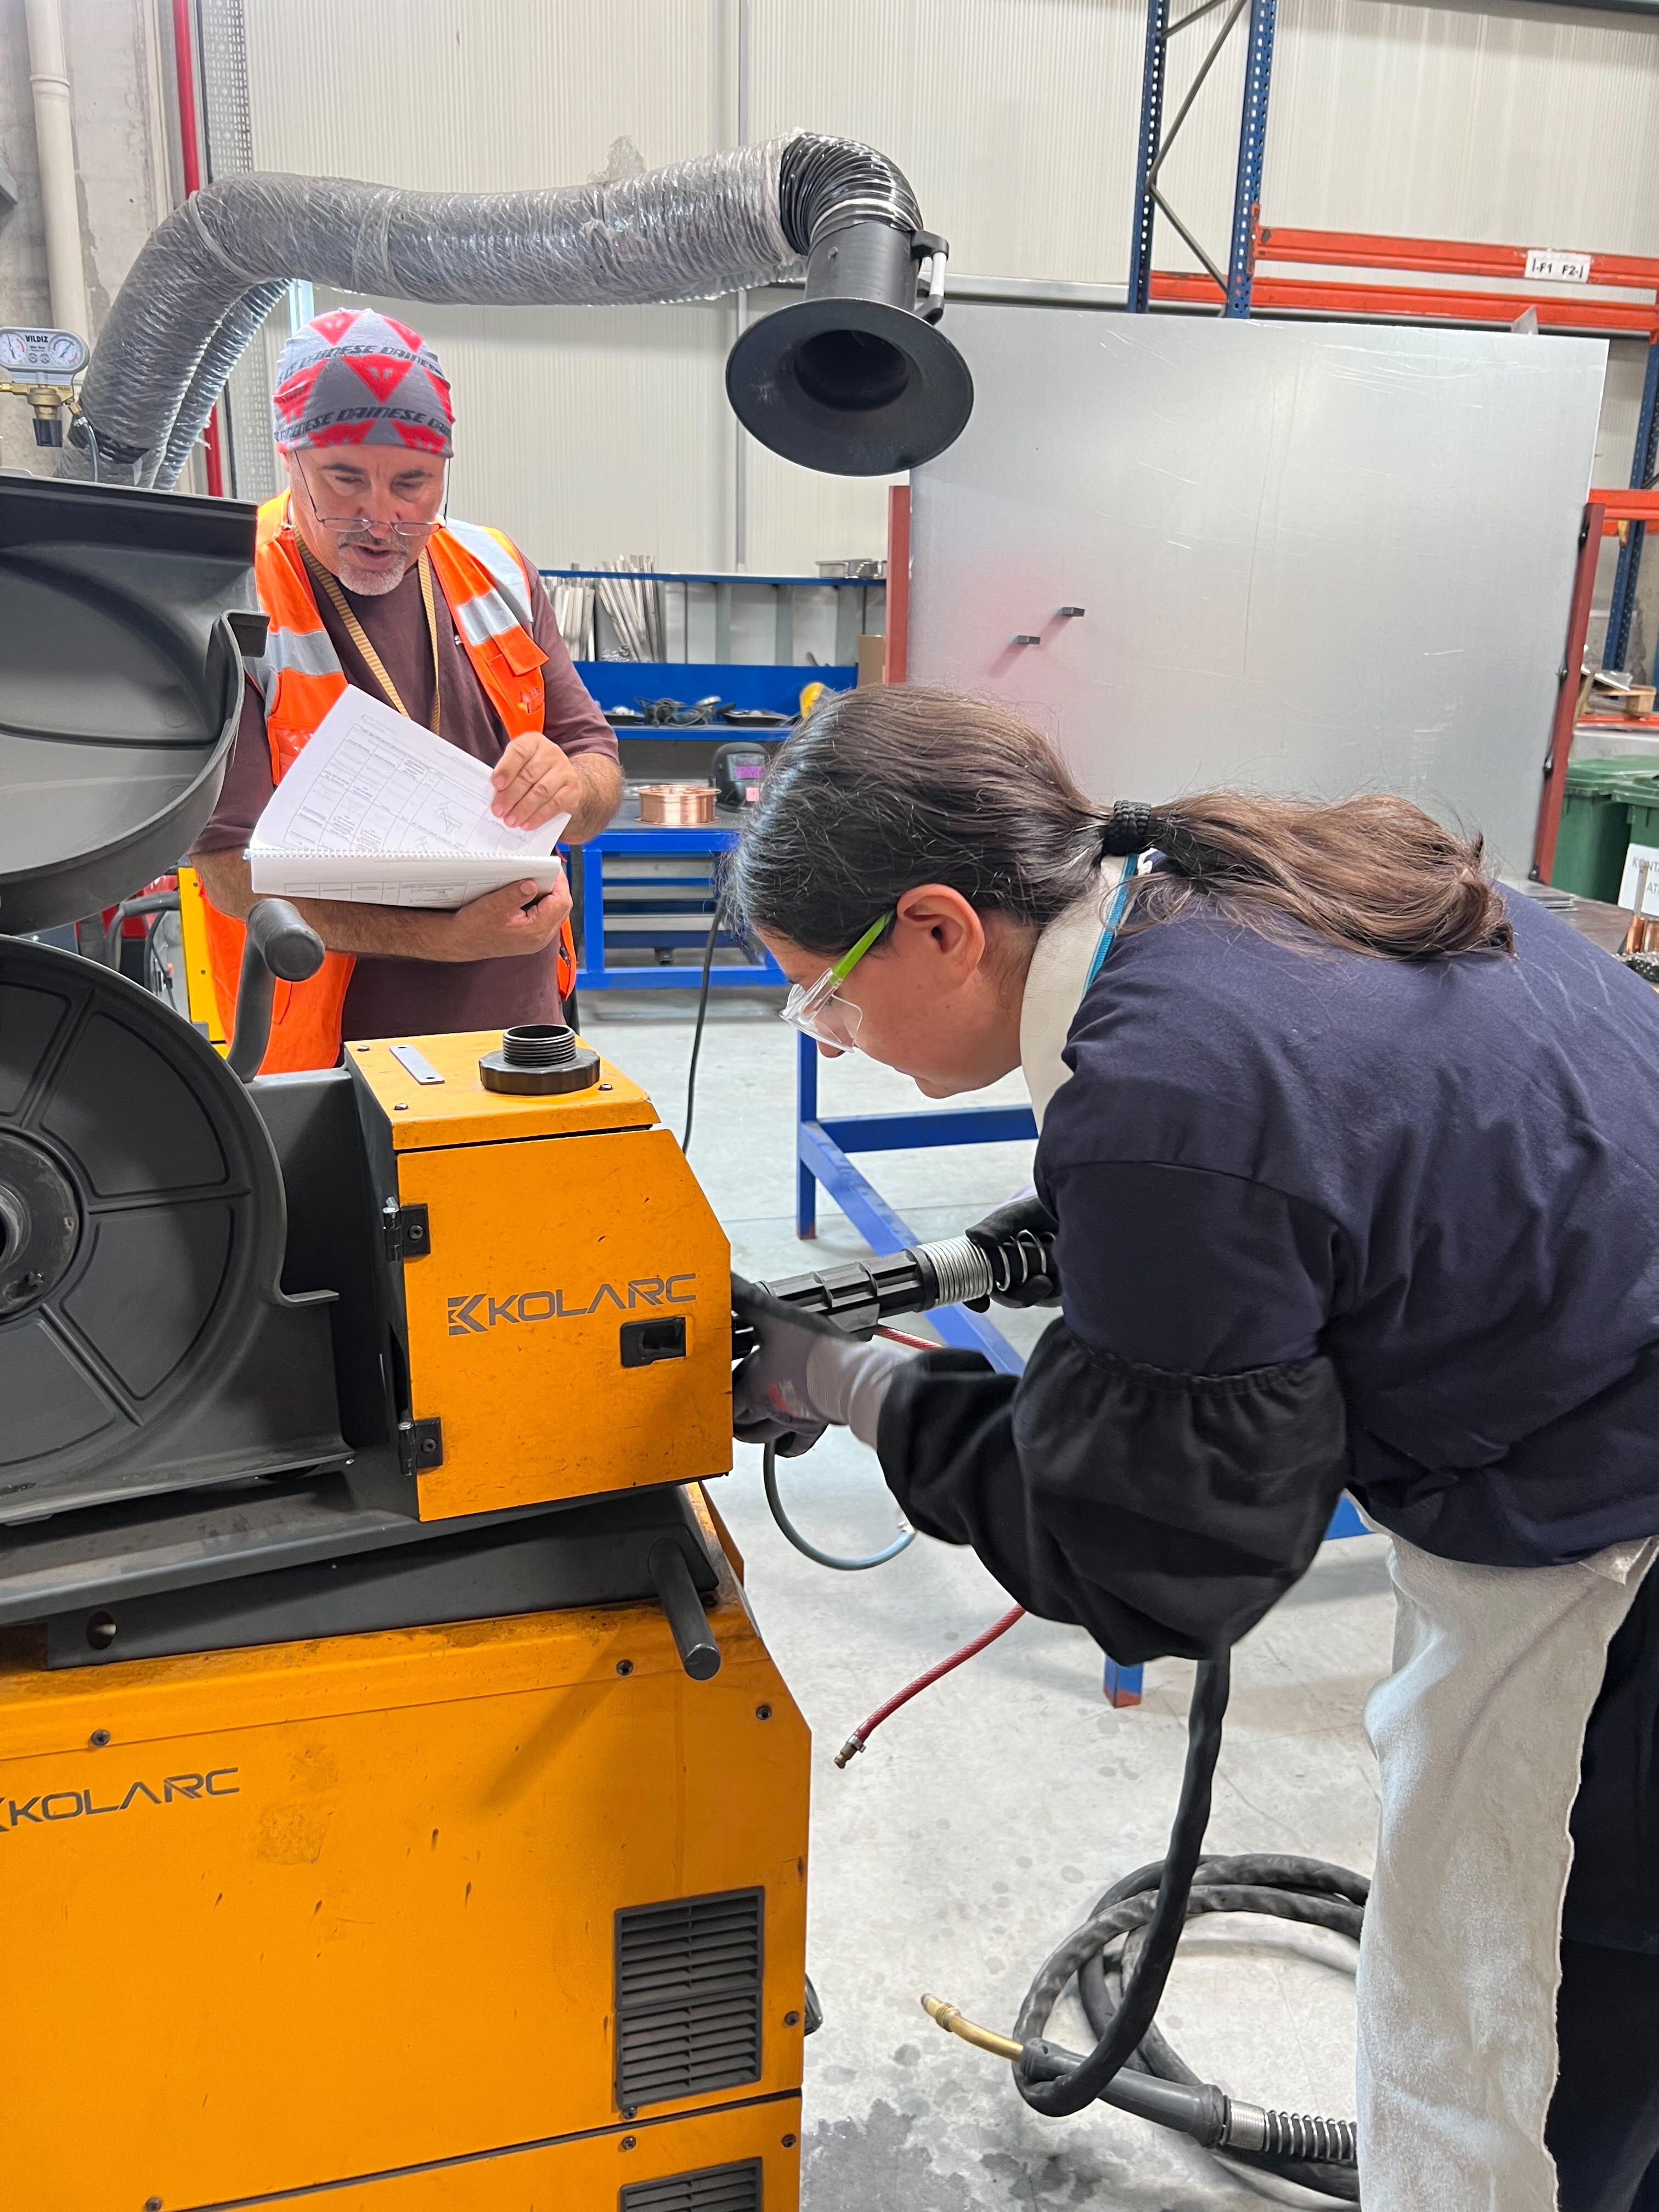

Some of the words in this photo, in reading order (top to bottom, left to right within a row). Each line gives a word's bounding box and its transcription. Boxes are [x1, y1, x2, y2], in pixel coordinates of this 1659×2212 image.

[25, 335, 48, 343] YILDIZ
[336, 407, 427, 423] DAINESE
[488, 1273, 696, 1326] KOLARC
[9, 1767, 240, 1826] KOLARC
